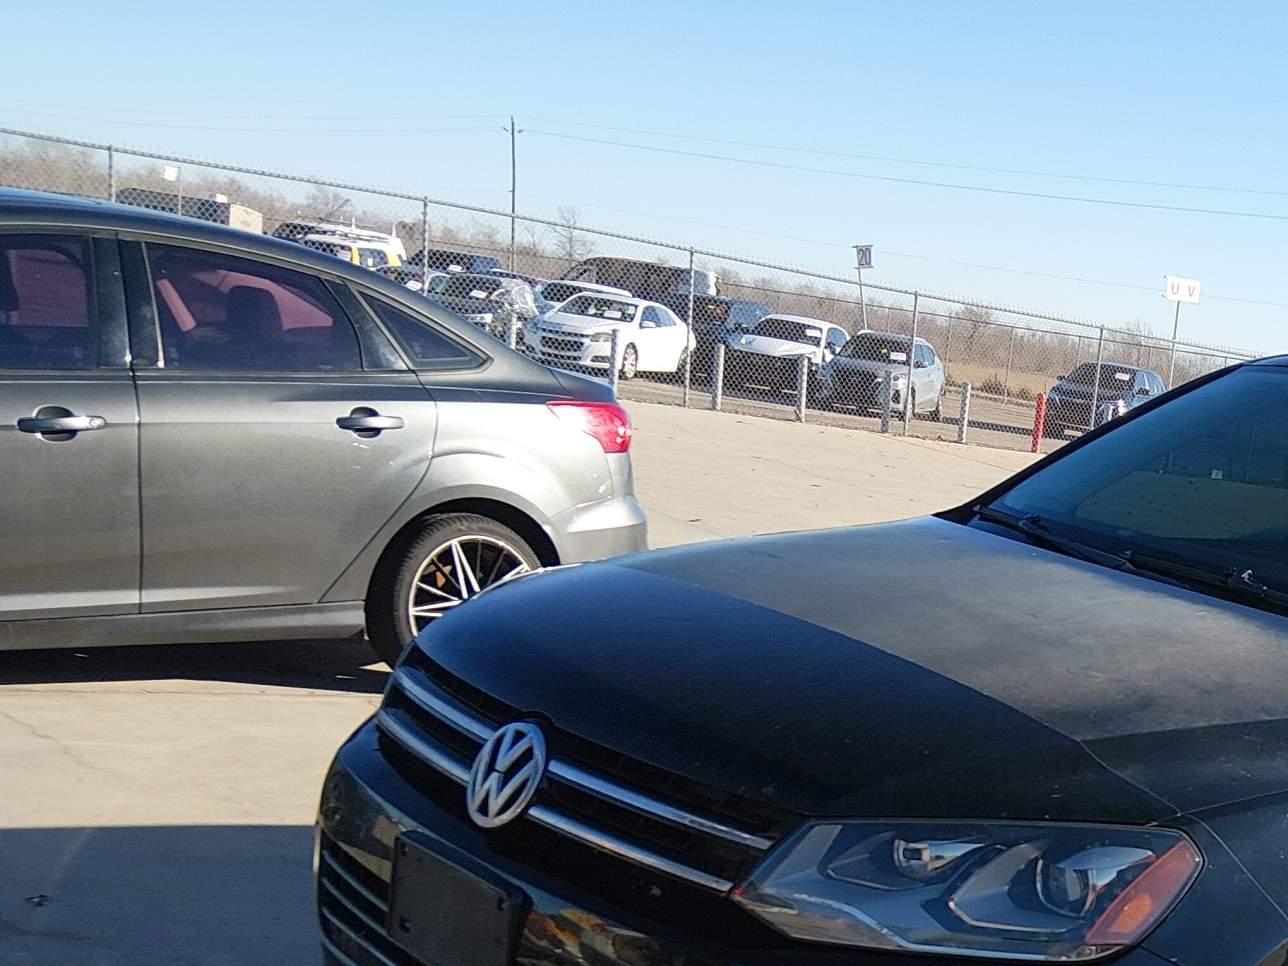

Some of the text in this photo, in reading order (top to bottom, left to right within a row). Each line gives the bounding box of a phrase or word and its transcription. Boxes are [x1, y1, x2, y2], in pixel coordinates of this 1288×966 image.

[858, 247, 871, 266] 20
[1171, 282, 1196, 297] U V
[467, 722, 546, 828] VW
